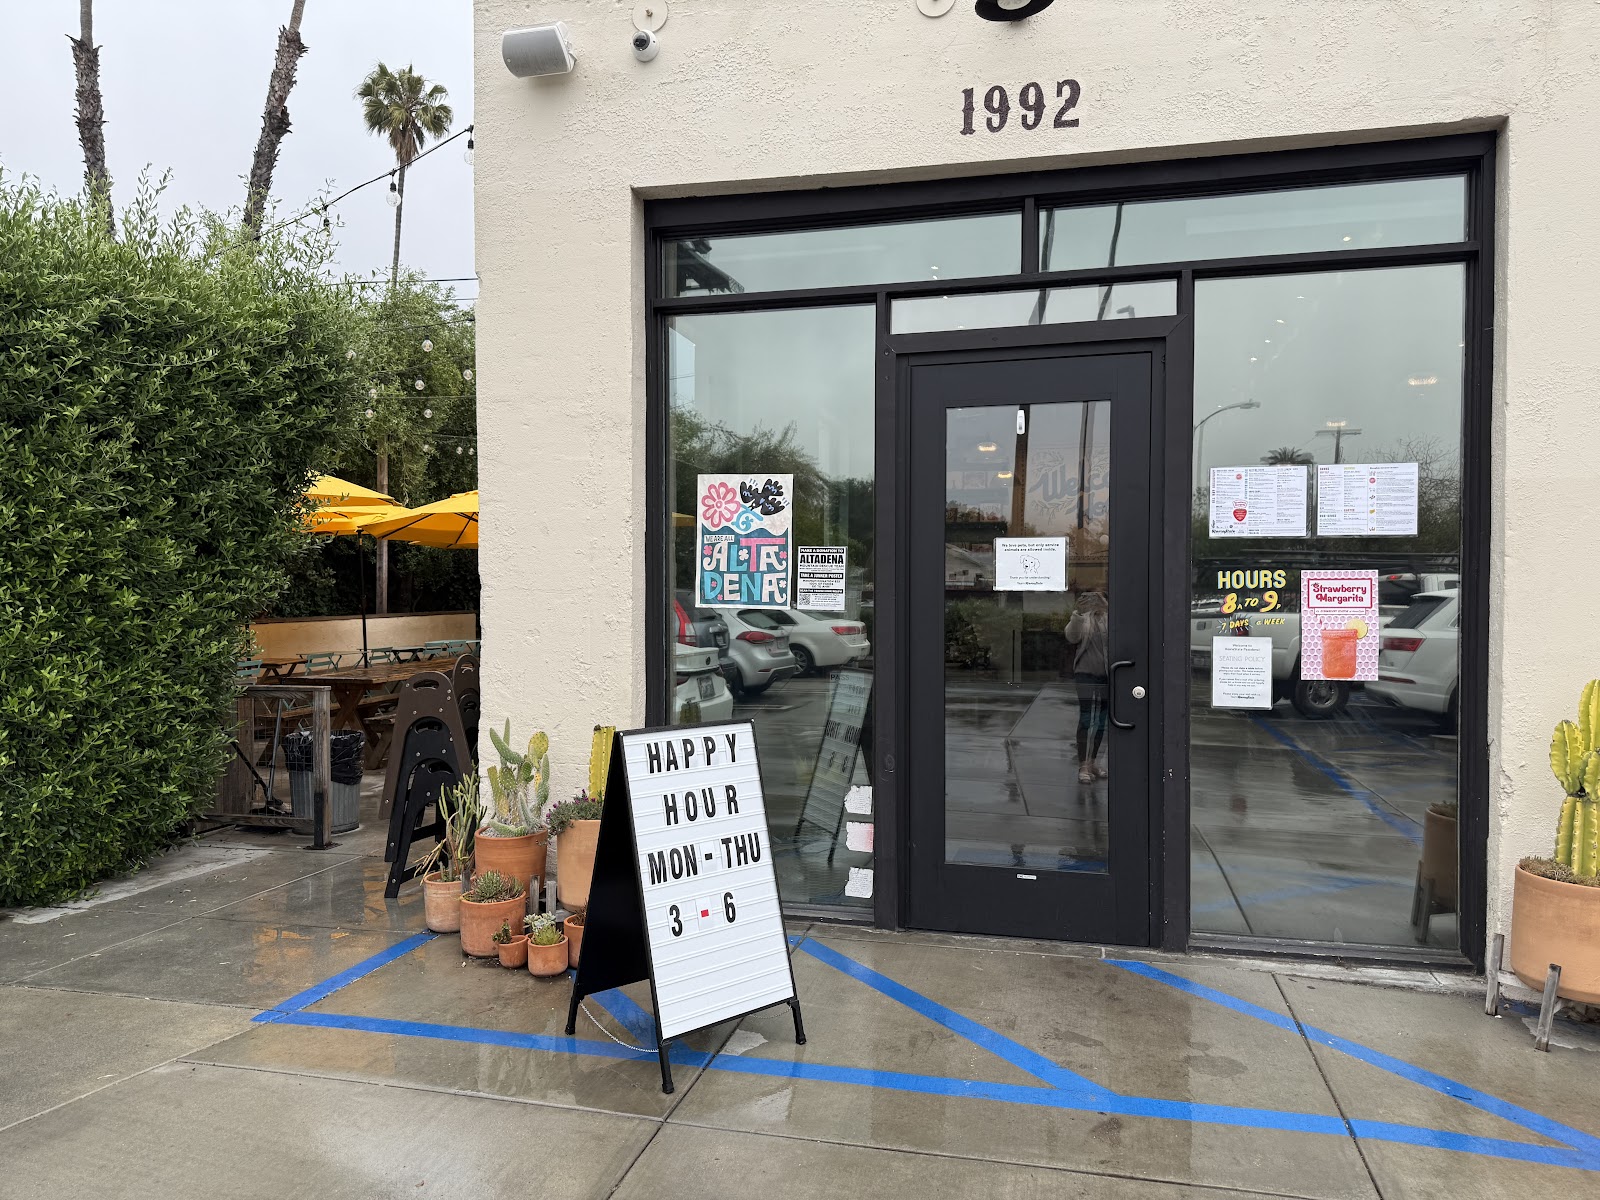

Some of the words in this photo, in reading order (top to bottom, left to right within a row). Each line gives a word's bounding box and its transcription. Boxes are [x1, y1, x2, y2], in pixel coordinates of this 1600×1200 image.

[960, 79, 1081, 136] 1992
[703, 537, 787, 572] ALTA
[800, 554, 844, 564] ALTADENA
[703, 571, 787, 603] DENA
[1217, 570, 1287, 589] HOURS
[1312, 583, 1366, 595] Strawberry
[1244, 597, 1259, 607] TO
[1315, 593, 1364, 604] Margarita
[1221, 622, 1226, 630] 7
[1229, 618, 1249, 629] DAYS
[1263, 617, 1285, 626] WEEK
[646, 733, 737, 774] HAPPY
[663, 784, 740, 825] HOUR
[668, 904, 683, 938] 3
[722, 892, 736, 924] 6
